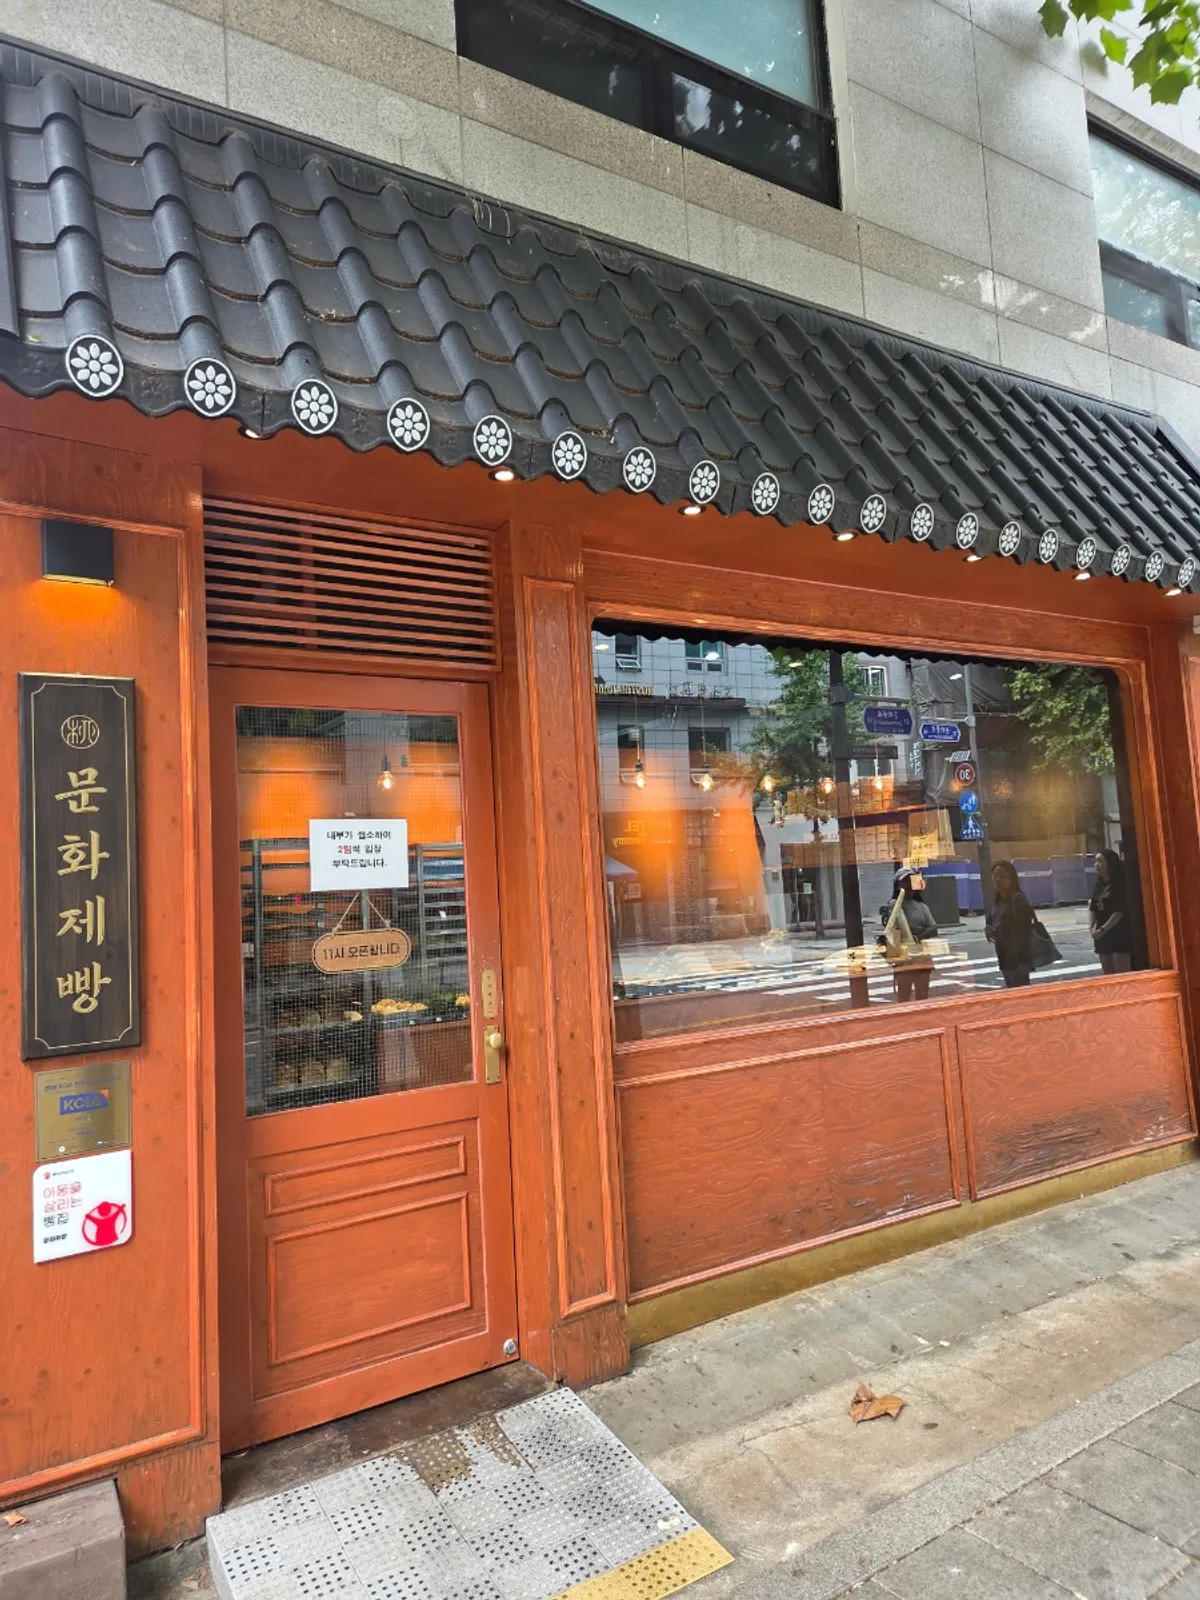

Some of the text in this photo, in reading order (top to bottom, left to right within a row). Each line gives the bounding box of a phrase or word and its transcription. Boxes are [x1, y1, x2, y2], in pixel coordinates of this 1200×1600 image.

[326, 831, 353, 840] 내부가
[332, 858, 388, 868] 부탁드립니다.
[55, 766, 112, 1014] 문화제빵
[323, 942, 400, 960] 11시 오픈합니다
